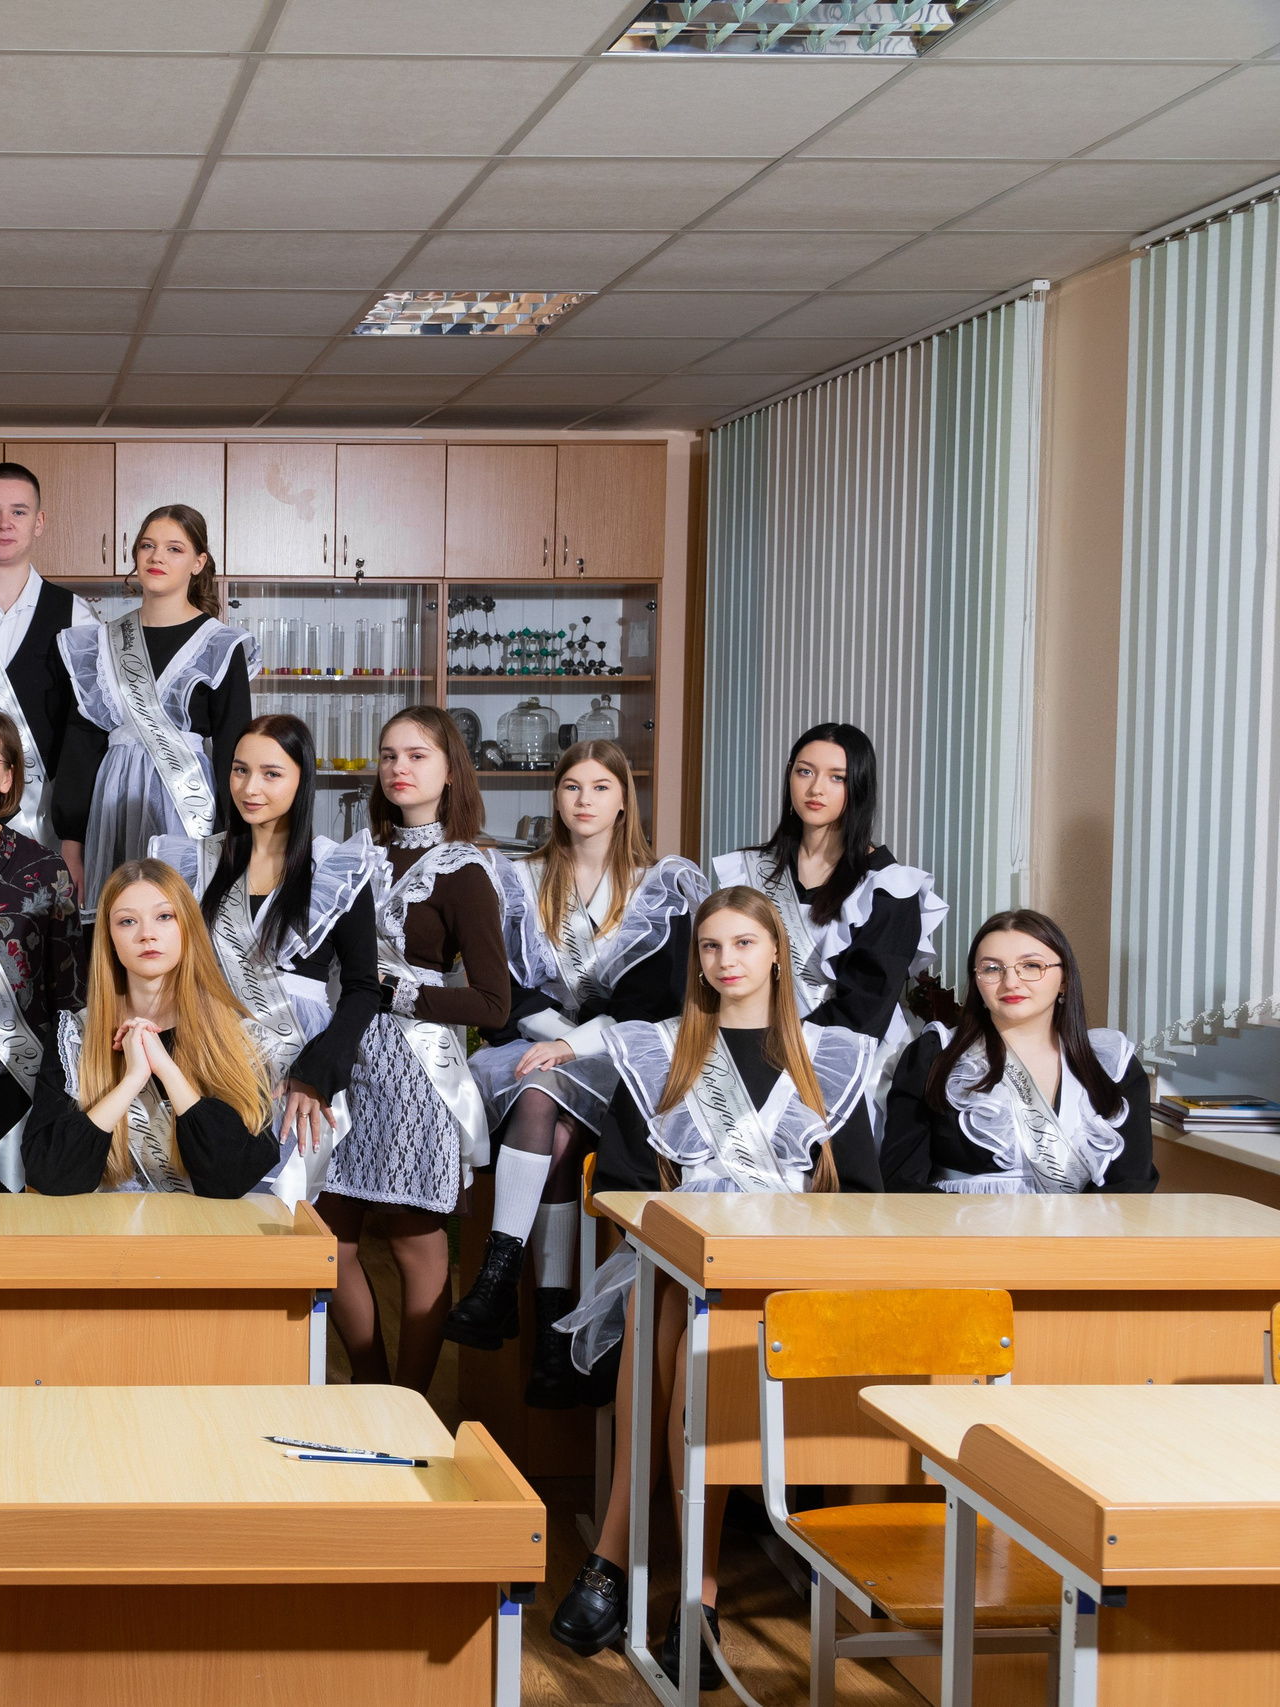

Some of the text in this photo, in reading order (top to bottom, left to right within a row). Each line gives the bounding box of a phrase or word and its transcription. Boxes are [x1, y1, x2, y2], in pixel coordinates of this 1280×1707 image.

[120, 653, 184, 773] Выпускница
[178, 779, 215, 838] 2025
[413, 1020, 460, 1069] 025
[128, 1087, 190, 1193] пускниц
[696, 1046, 771, 1190] Выпускница
